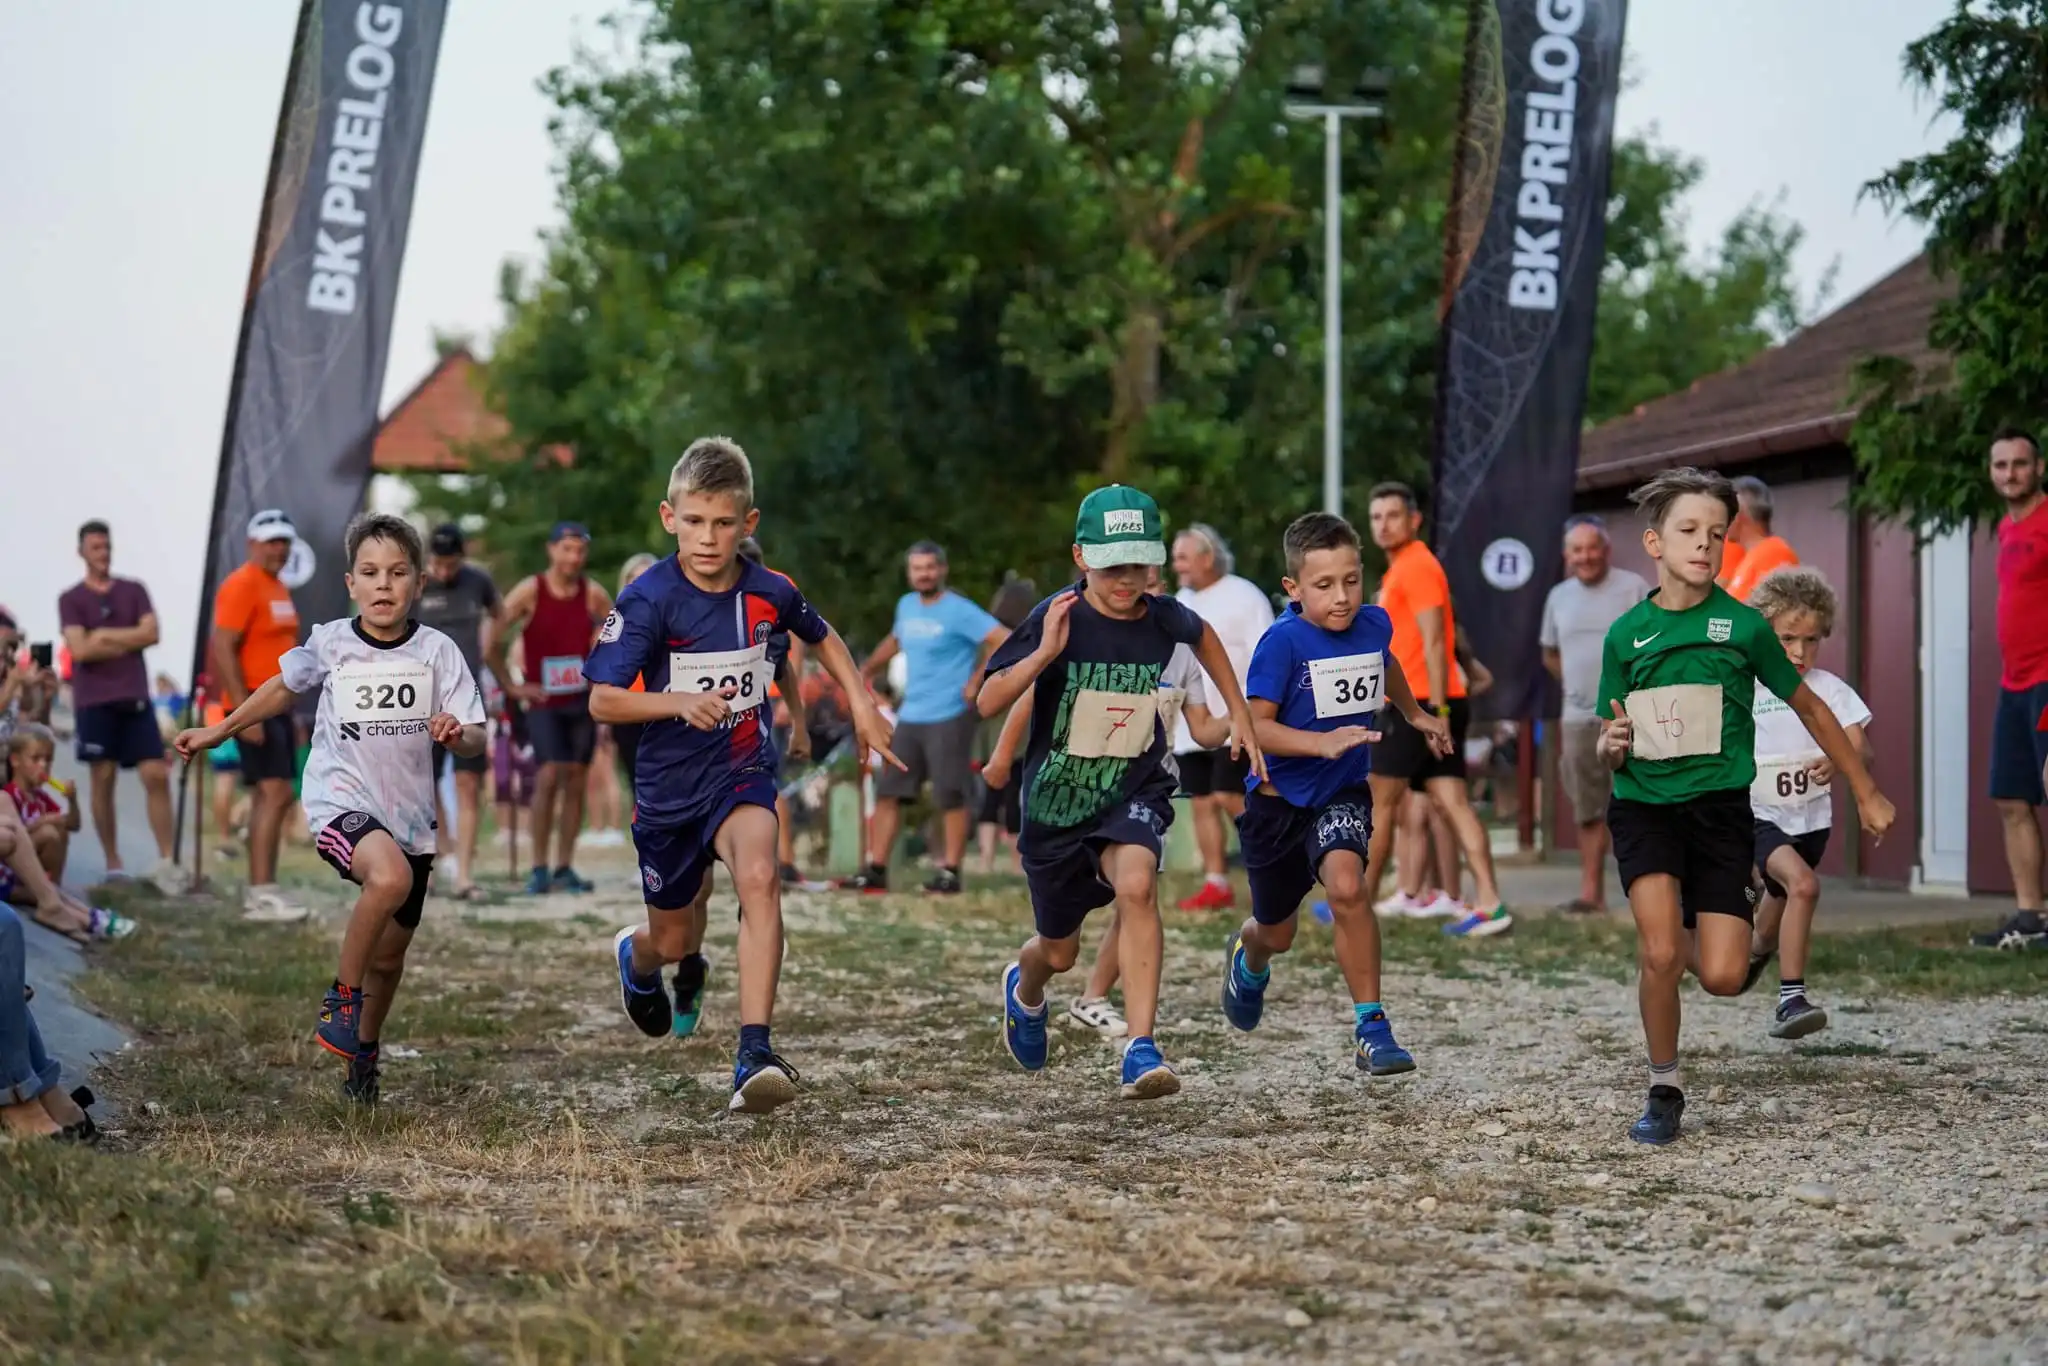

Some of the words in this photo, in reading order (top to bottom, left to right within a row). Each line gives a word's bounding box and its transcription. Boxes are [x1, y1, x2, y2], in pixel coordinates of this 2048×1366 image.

[320, 0, 403, 227] PRELOG
[1517, 0, 1586, 222] PRELOG
[306, 228, 364, 315] BK
[1508, 226, 1561, 310] BK
[1108, 522, 1142, 533] VIBES
[355, 683, 416, 710] 320
[696, 671, 754, 701] 308
[1334, 674, 1380, 704] 367
[366, 721, 432, 737] chartere
[1106, 706, 1135, 742] 7
[1651, 697, 1685, 741] 46
[1776, 769, 1809, 798] 69
